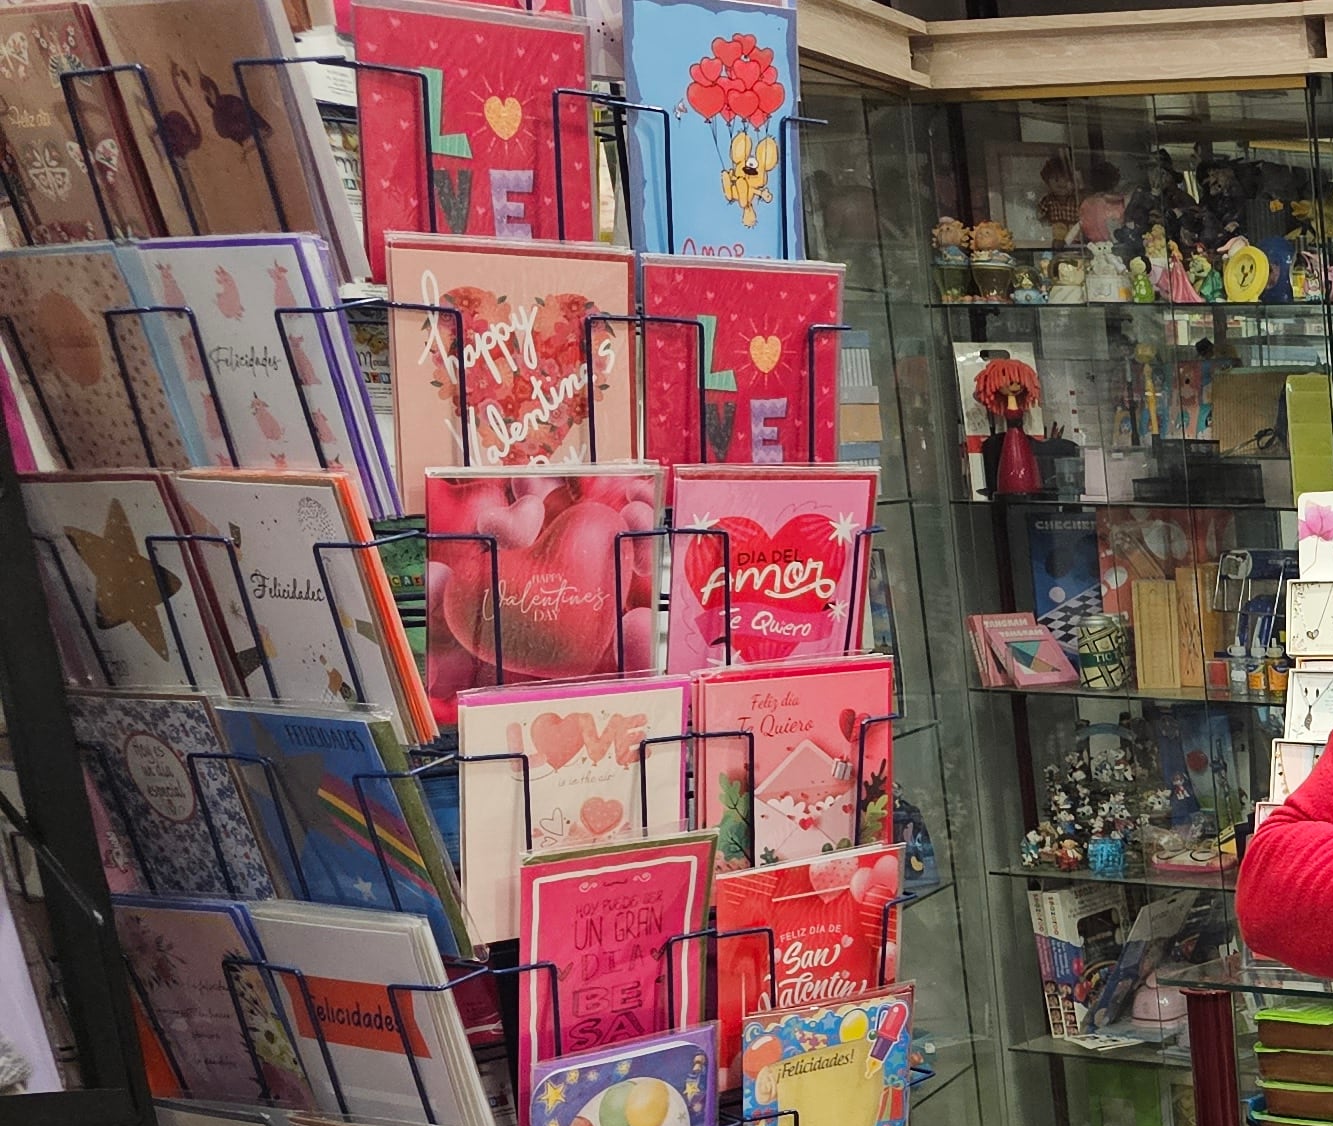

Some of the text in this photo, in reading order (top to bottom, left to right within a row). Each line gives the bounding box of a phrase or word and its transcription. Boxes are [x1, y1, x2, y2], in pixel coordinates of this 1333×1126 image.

[211, 341, 283, 380] Felicidades
[249, 570, 326, 603] Felicidades
[531, 573, 565, 585] HAPPY
[533, 606, 560, 623] DAY
[573, 906, 663, 951] UN GRAN
[780, 923, 842, 943] FELIZ DÍA DE
[782, 940, 842, 975] San
[775, 1049, 856, 1084] ¡Felicidades!
